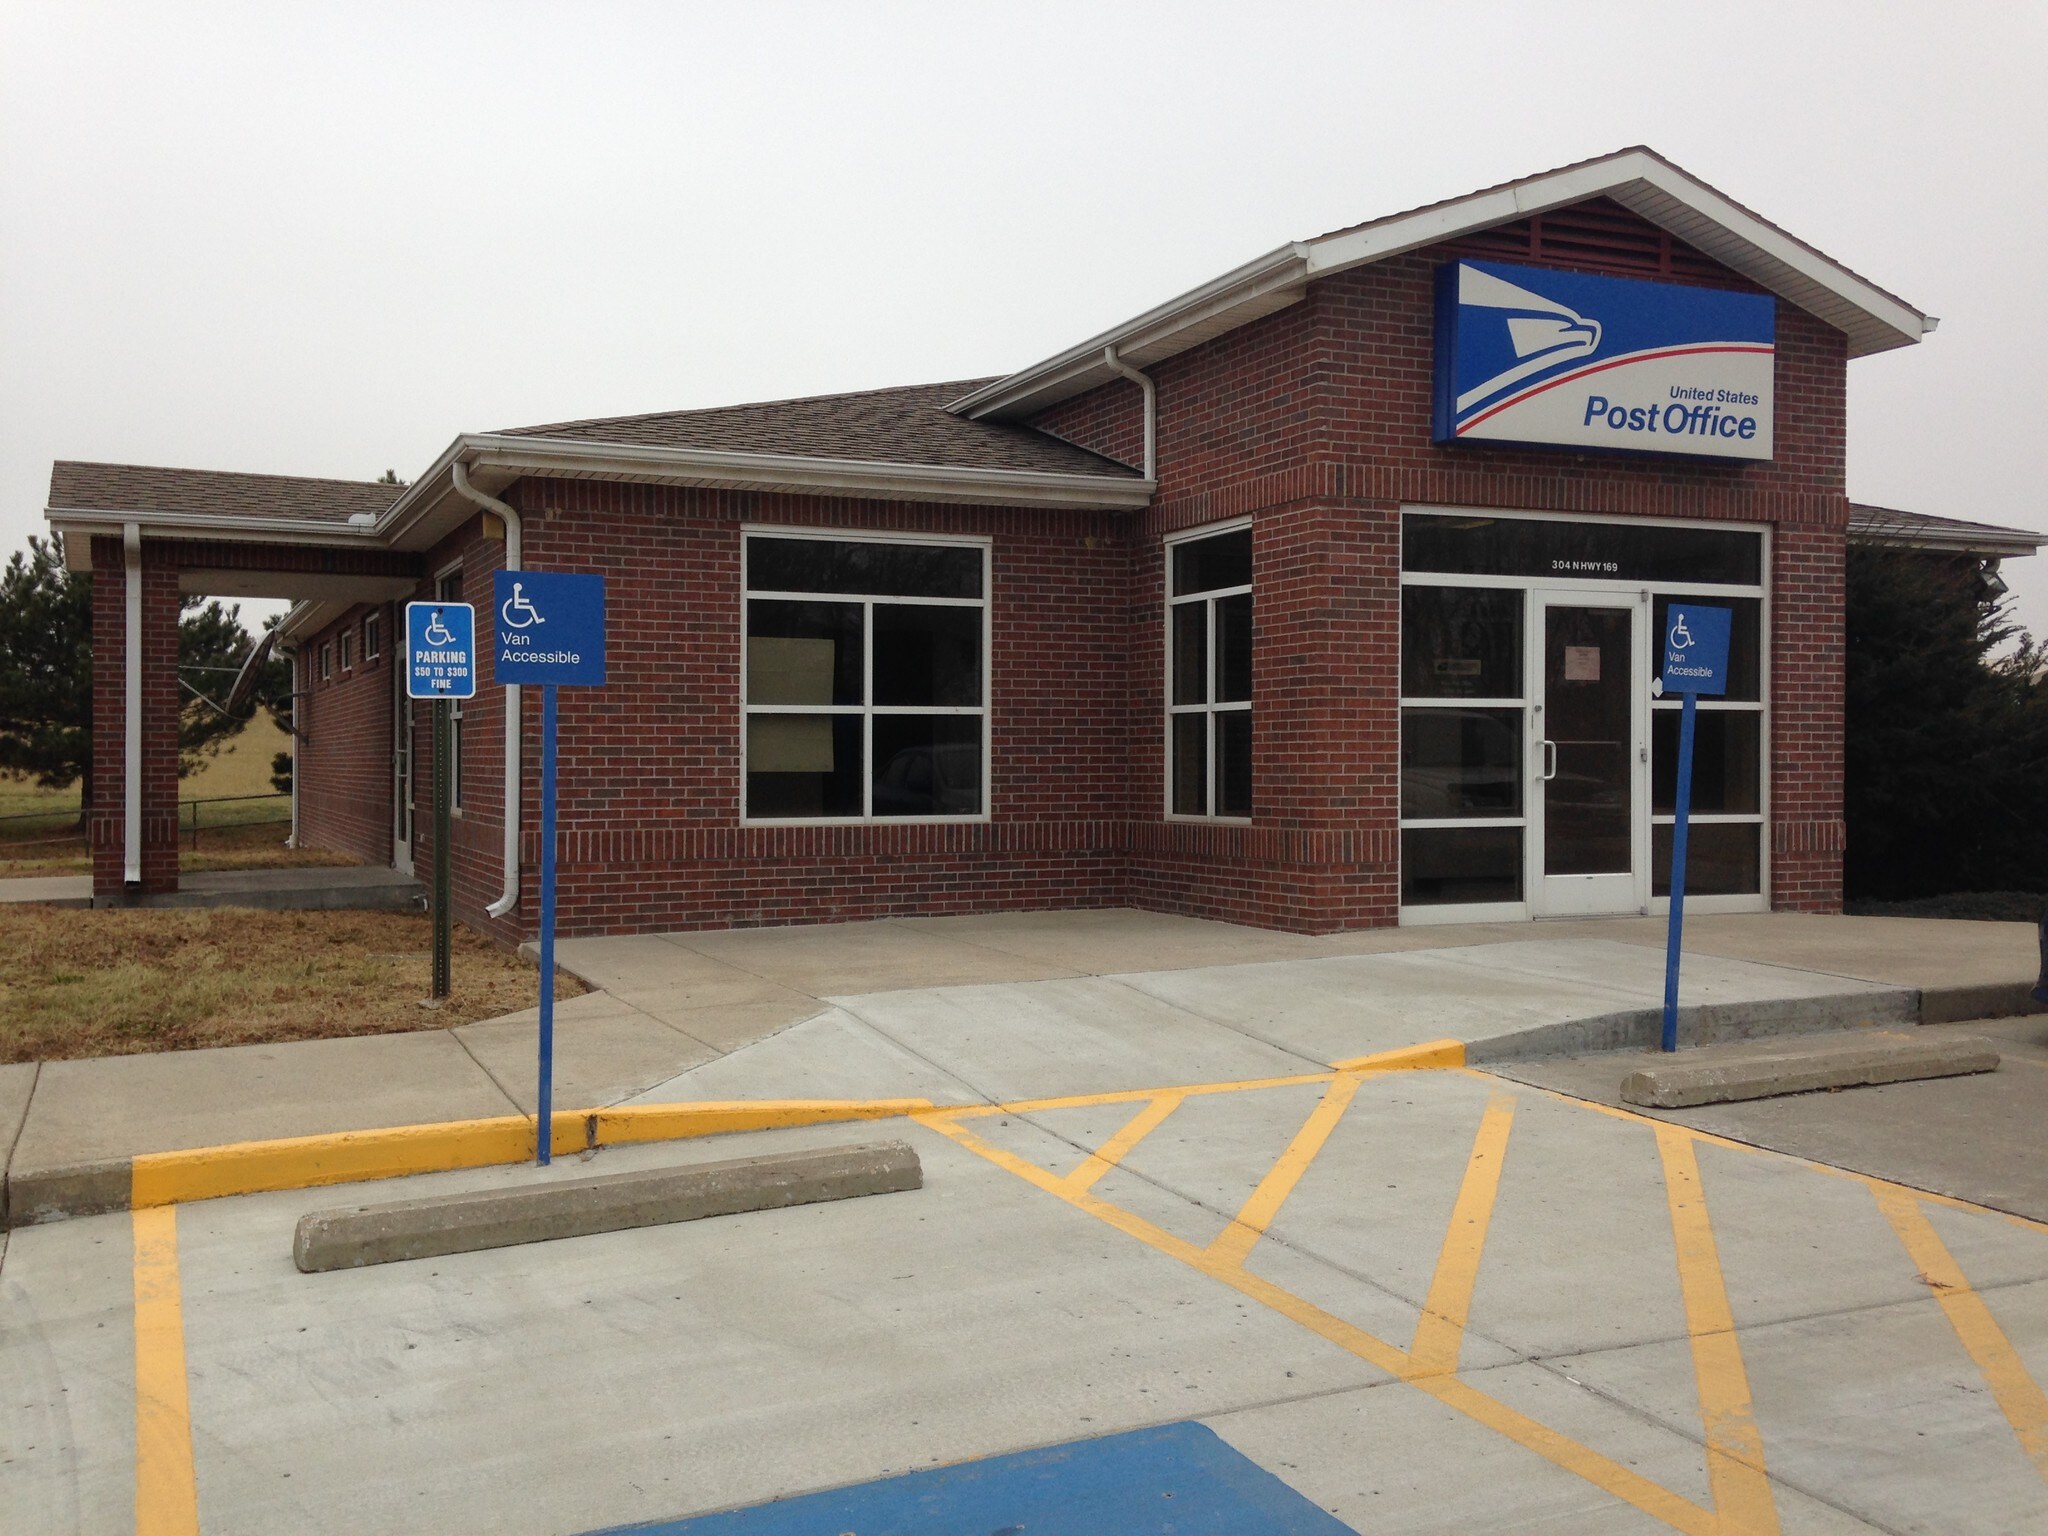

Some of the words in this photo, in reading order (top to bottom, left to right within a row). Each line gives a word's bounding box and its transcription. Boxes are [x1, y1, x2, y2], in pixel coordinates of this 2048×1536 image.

[1669, 385, 1715, 402] United
[1717, 388, 1759, 405] States
[1583, 395, 1660, 432] Post
[1663, 403, 1757, 440] Office
[1552, 560, 1571, 570] 304
[1580, 562, 1602, 571] HWY
[1603, 562, 1618, 572] 169
[501, 632, 530, 646] Van
[416, 651, 466, 664] PARKING
[501, 649, 580, 664] Accessible
[1668, 651, 1686, 662] Van
[414, 666, 431, 677] $50
[434, 667, 444, 677] TO
[447, 667, 468, 677] $300
[1667, 664, 1713, 678] Accessible
[431, 679, 452, 689] FINE
